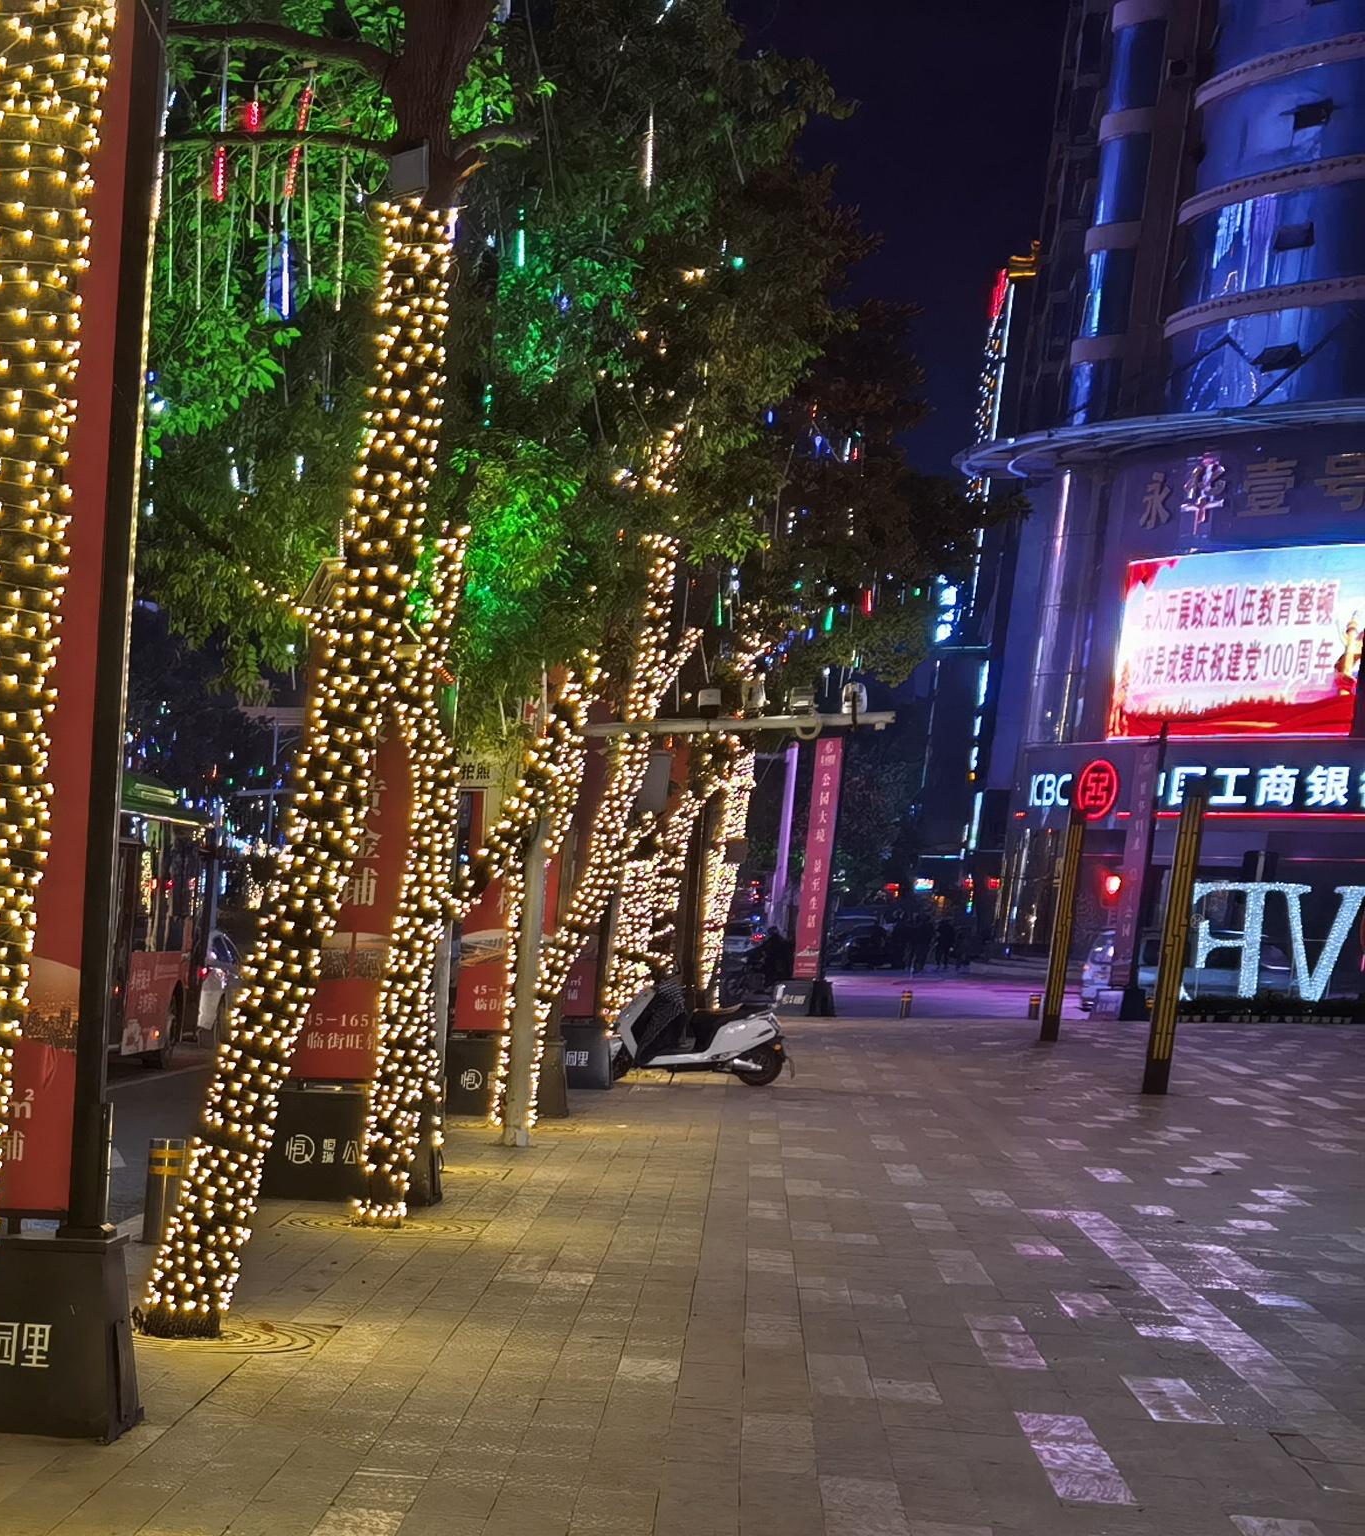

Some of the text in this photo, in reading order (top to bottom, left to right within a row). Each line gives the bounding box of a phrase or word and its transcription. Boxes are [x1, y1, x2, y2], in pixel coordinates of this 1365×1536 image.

[1028, 773, 1073, 807] ICBC
[1158, 765, 1365, 807] 工商银
